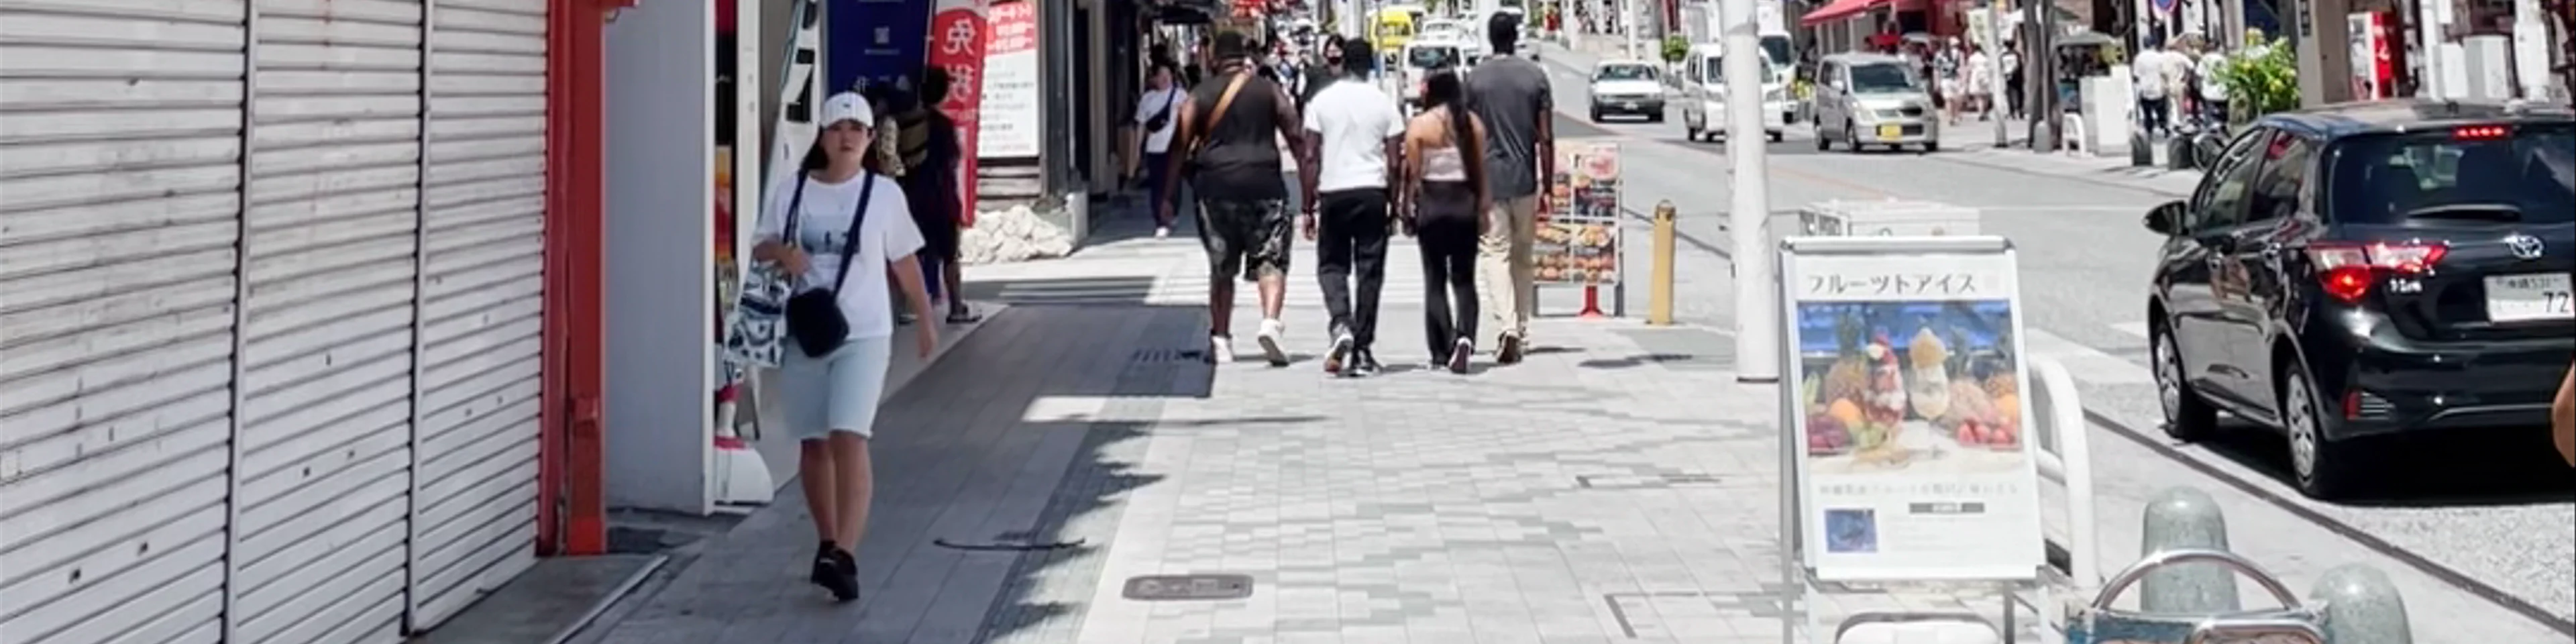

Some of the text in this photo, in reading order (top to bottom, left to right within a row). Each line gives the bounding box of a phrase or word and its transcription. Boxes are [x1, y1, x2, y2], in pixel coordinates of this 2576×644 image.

[1808, 274, 1976, 294] フルーツトアイス
